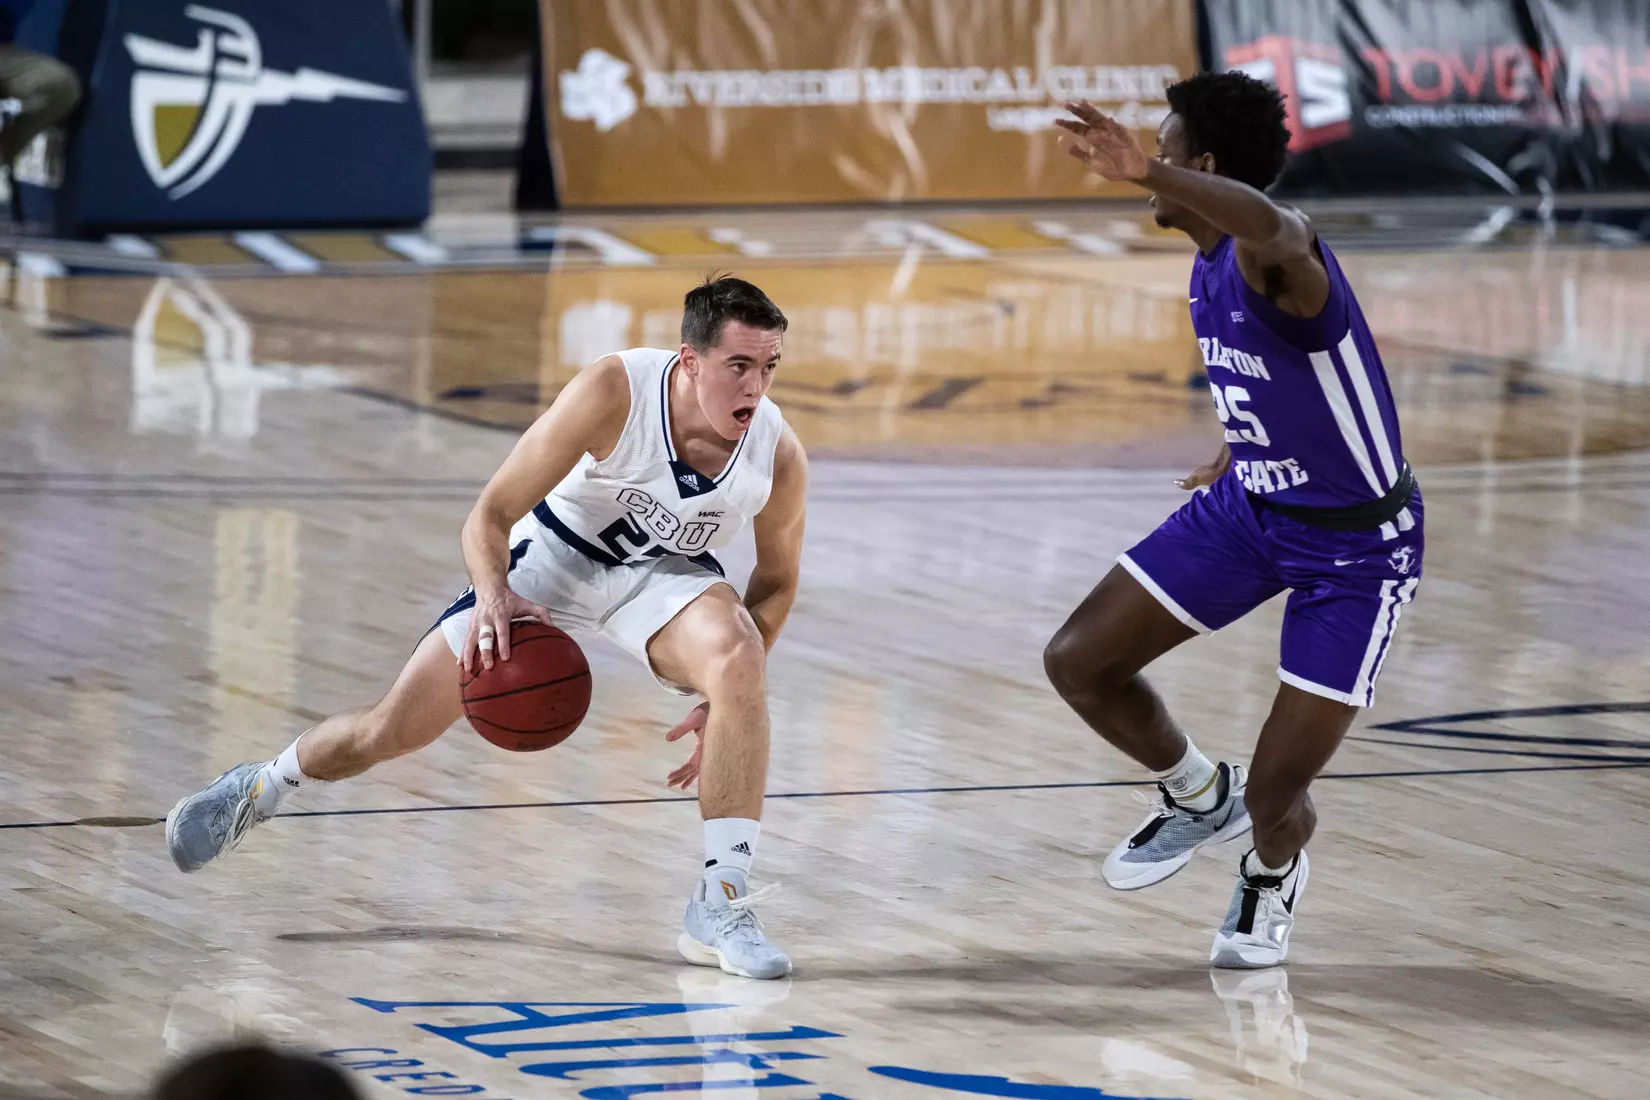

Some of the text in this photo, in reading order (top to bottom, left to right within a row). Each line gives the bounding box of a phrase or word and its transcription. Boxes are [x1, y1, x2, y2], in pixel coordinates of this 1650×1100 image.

[616, 487, 720, 552] CBU
[698, 510, 725, 518] WAC
[318, 1047, 514, 1100] CRED
